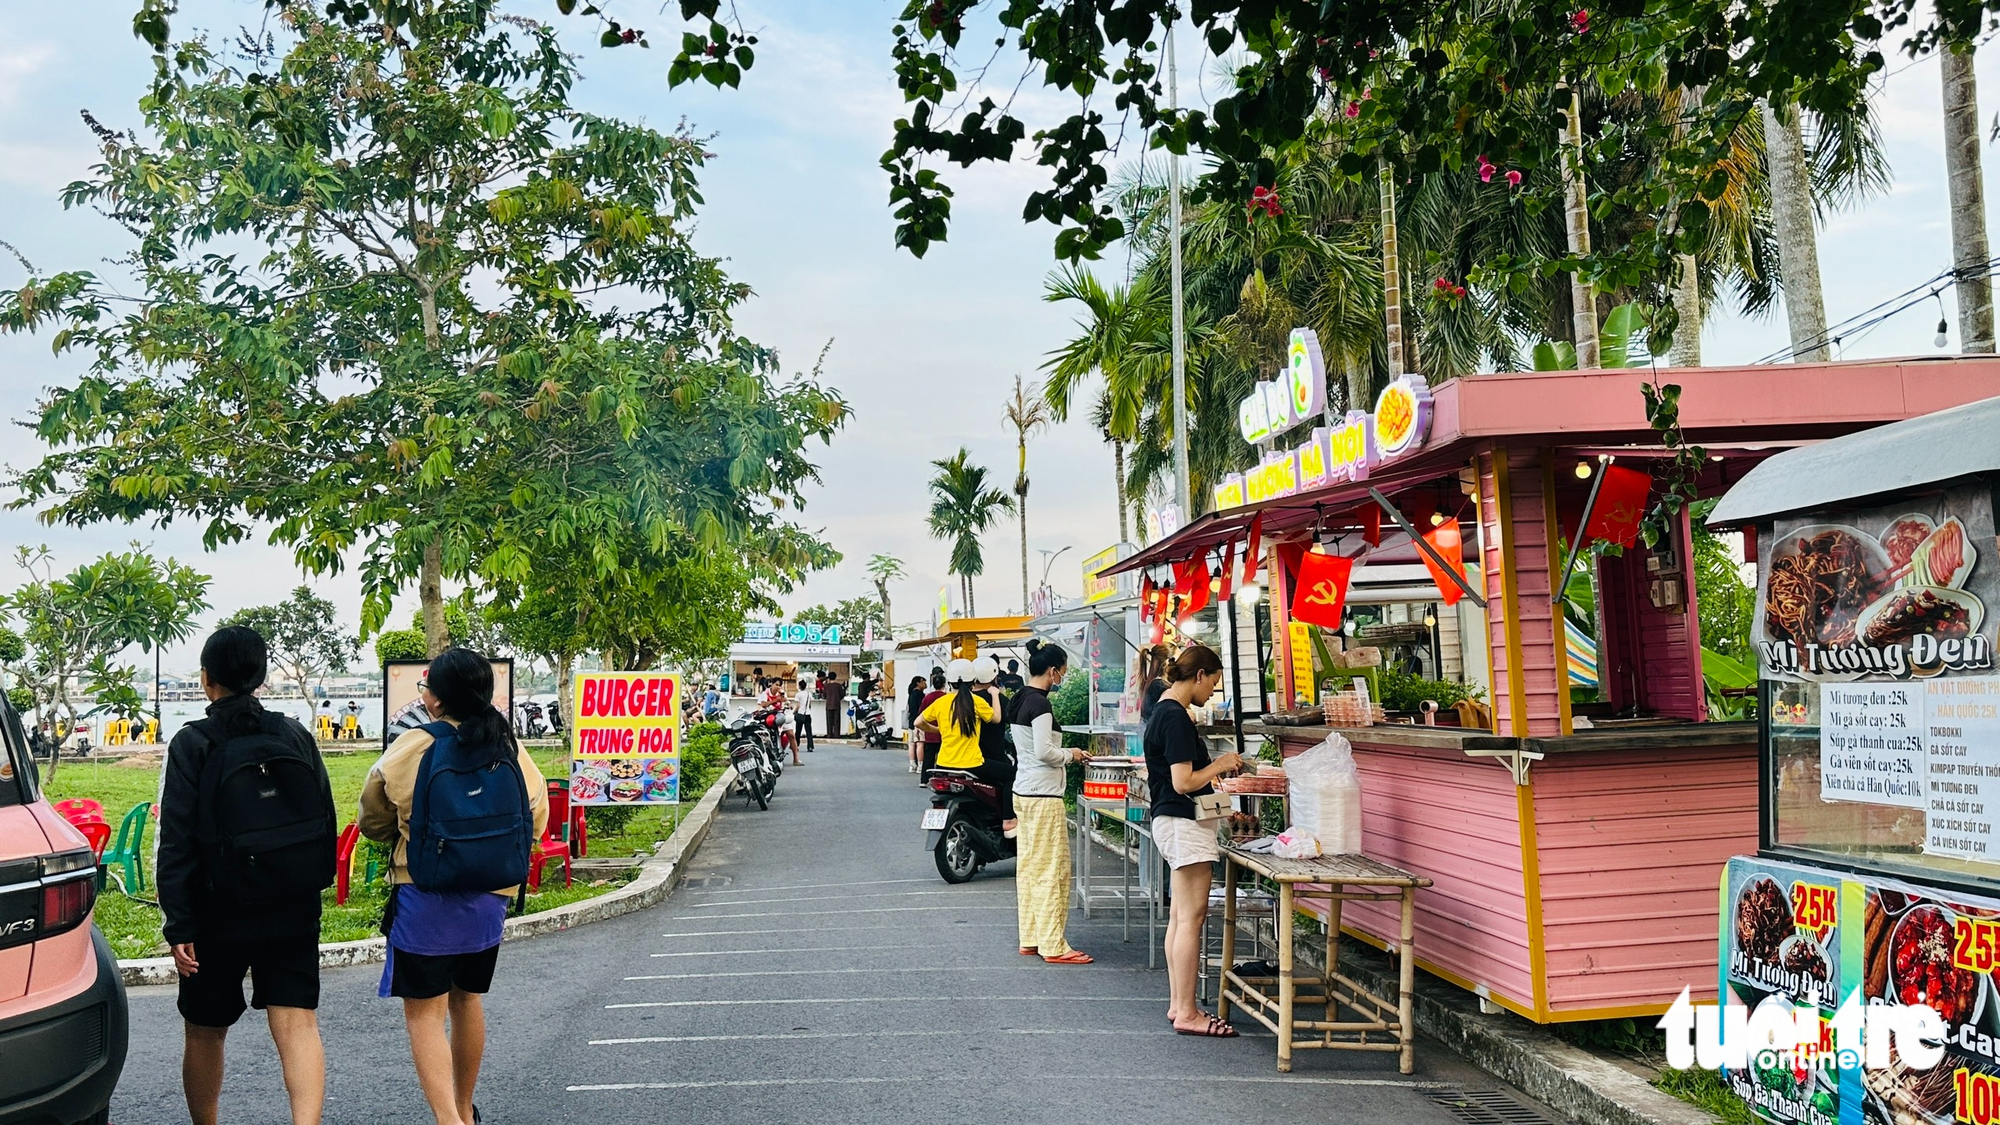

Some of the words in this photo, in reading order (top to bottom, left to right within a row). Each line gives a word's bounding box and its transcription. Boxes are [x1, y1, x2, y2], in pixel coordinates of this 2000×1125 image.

[1330, 412, 1367, 481] NỘI
[779, 623, 840, 644] 1954
[806, 646, 840, 654] COFFEE
[1760, 639, 1798, 668] Mì
[1805, 643, 1905, 676] Tương
[1909, 633, 1985, 665] Đen
[580, 678, 674, 717] BURGER
[1830, 690, 1842, 705] Mì
[1843, 694, 1868, 708] tương
[1870, 691, 1886, 705] đen
[1937, 701, 1955, 718] HÀN
[1956, 700, 1979, 719] QUỐC
[1981, 704, 1998, 719] 25K
[1830, 711, 1842, 726] Mì
[1843, 713, 1853, 729] gà
[1855, 708, 1868, 727] sốt
[1869, 716, 1887, 731] cay:
[1890, 713, 1906, 728] 25k
[579, 728, 634, 754] TRUNG
[637, 728, 673, 754] HOA
[1930, 726, 1962, 738] TOKBOKKI
[1829, 733, 1845, 750] Súp
[1847, 735, 1858, 752] gà
[1860, 735, 1884, 750] thanh
[1941, 741, 1953, 756] SỐT
[1954, 745, 1968, 757] CAY
[1830, 754, 1842, 769] Gà
[1844, 755, 1861, 770] viên
[1863, 752, 1876, 771] sốt
[1930, 763, 1956, 775] KIMPAP
[1825, 773, 1841, 789] Xiên
[1857, 777, 1865, 791] cá
[1866, 777, 1882, 793] Hàn
[1931, 780, 1939, 792] MÌ
[1941, 781, 1962, 794] TƯƠNG
[1964, 784, 1978, 795] ĐEN
[1931, 797, 1944, 811] CHẢ
[1946, 798, 1955, 812] CÁ
[1957, 798, 1969, 813] SỐT
[1971, 803, 1984, 815] CAY
[1931, 816, 1945, 830] XÚC
[1946, 817, 1962, 831] XÍCH
[1963, 818, 1976, 833] SỐT
[1978, 822, 1991, 834] CAY
[1932, 834, 1941, 847] CÁ
[1942, 836, 1957, 849] VIÊN
[1959, 836, 1972, 851] SỐT
[1973, 842, 1987, 853] CAY
[1795, 884, 1836, 929] 25K
[0, 918, 35, 937] VF3
[1731, 949, 1748, 975] Mì
[1753, 956, 1800, 996] Tương
[1801, 970, 1835, 1002] Đen
[1732, 1075, 1750, 1102] Súp
[1754, 1084, 1769, 1105] Gà
[1770, 1088, 1807, 1125] Thanh
[1810, 1105, 1833, 1125] Cua
